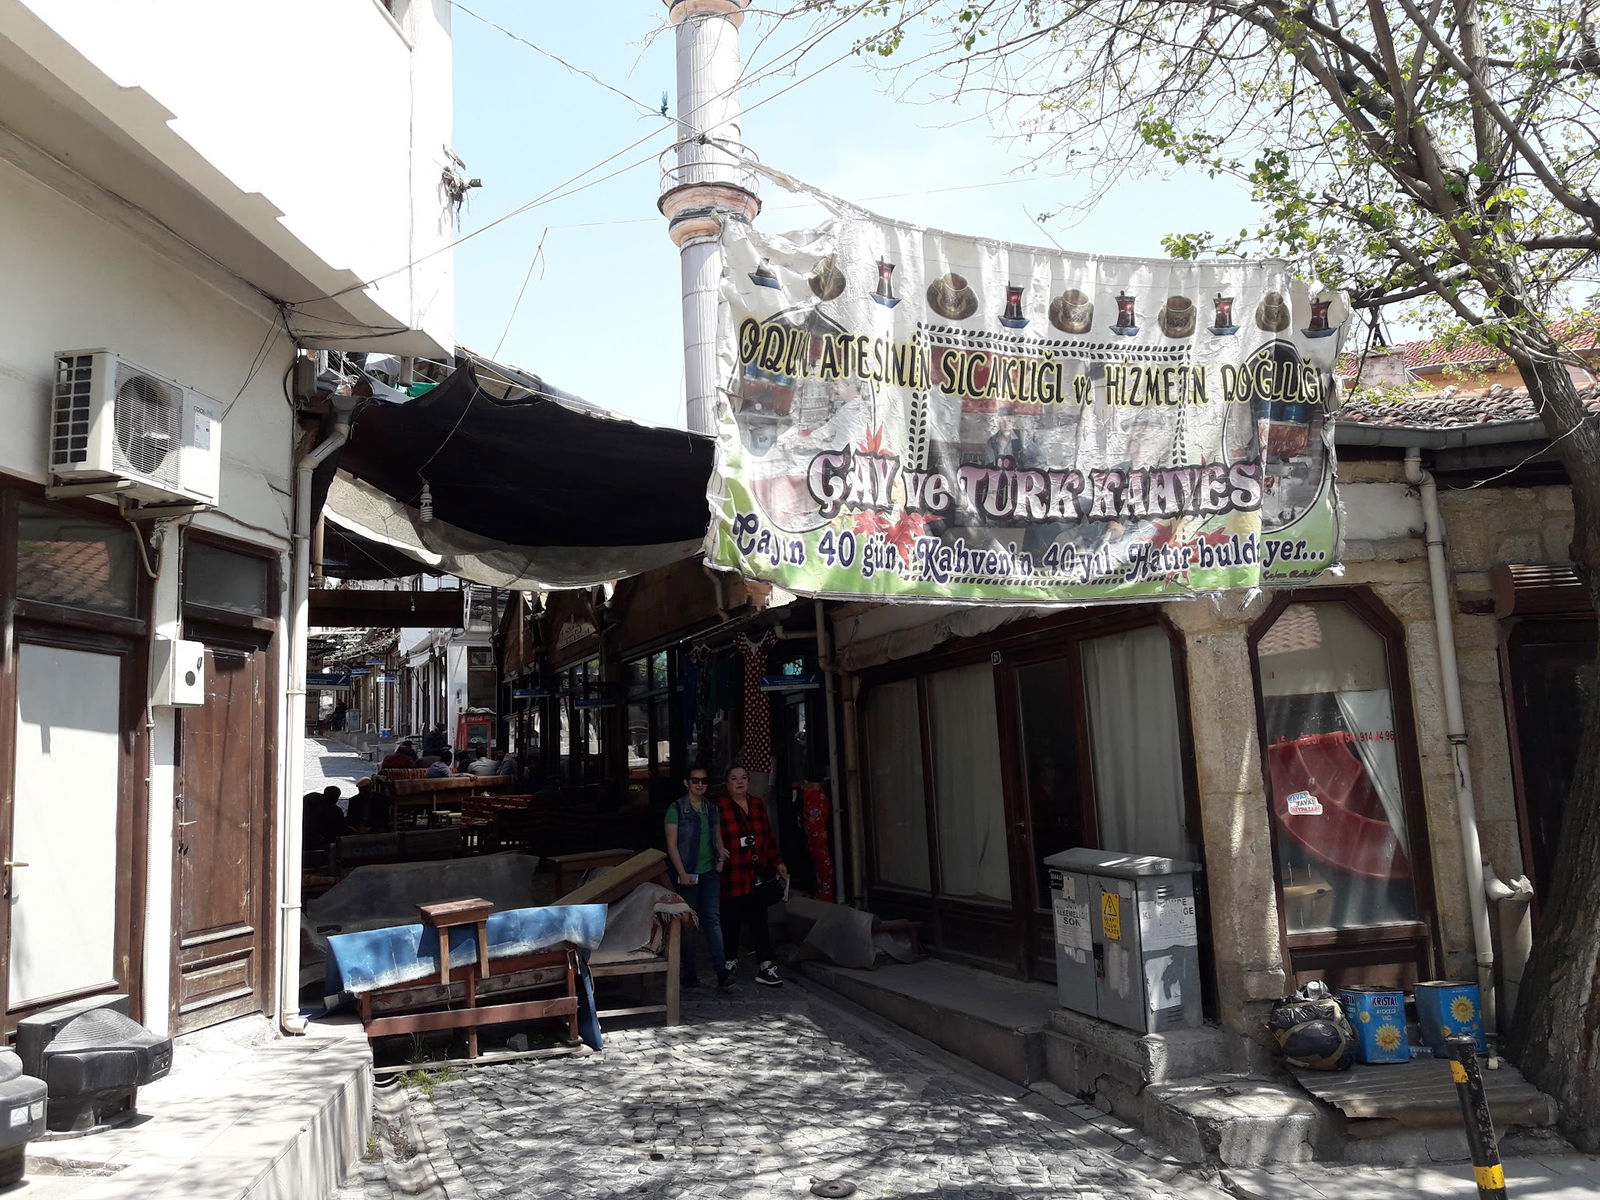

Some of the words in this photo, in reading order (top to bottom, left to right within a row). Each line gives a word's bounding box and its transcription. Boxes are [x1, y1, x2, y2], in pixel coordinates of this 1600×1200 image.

[740, 318, 809, 377] ODUN
[820, 330, 932, 394] ATEŞİNİN
[941, 351, 1064, 403] SICAKLIĞI
[1074, 376, 1093, 405] ve
[807, 444, 900, 519] ÇAY
[902, 467, 954, 513] ve
[957, 455, 1085, 523] TÜRK
[818, 530, 855, 567] 40
[917, 538, 1034, 583] Kahvenin
[1043, 543, 1075, 577] 40
[1079, 545, 1112, 583] yıl
[1126, 542, 1191, 581] Hatır
[1262, 540, 1325, 568] yer...
